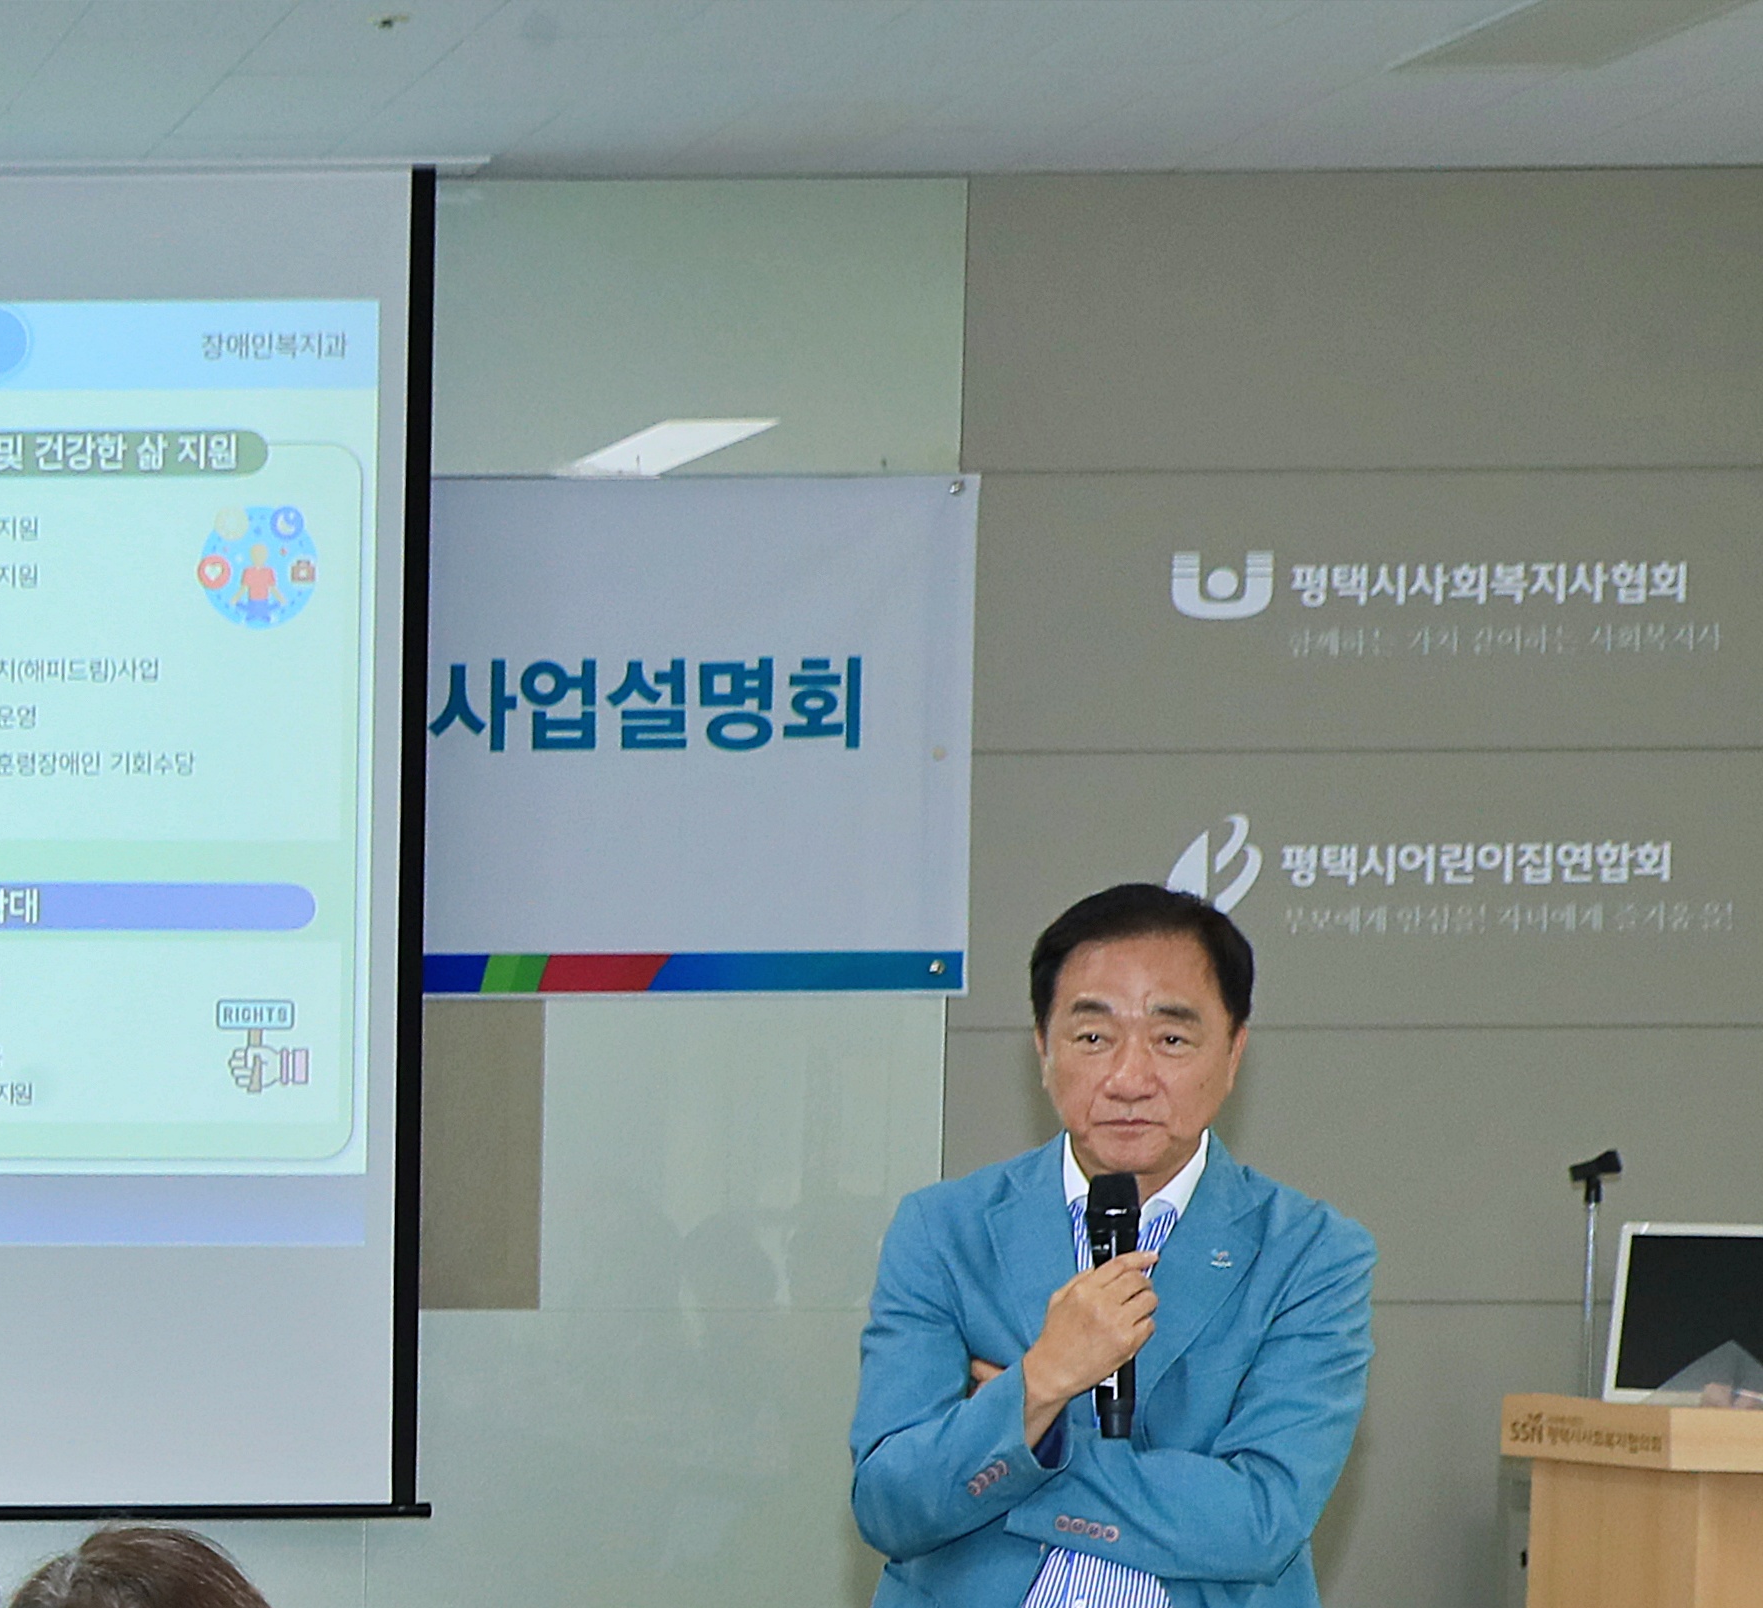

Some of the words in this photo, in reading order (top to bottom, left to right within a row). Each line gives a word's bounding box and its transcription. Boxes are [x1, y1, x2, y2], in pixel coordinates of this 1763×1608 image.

[201, 332, 348, 361] 장애인복지과
[34, 433, 128, 473] 건강한
[136, 433, 168, 473] 삶
[177, 433, 239, 473] 지원
[1290, 560, 1690, 607] 평택시사회복지사협회
[429, 655, 863, 753] 사업설명회
[109, 751, 196, 778] 기회수당
[1281, 840, 1674, 889] 평택시어린이집연합회
[223, 1007, 288, 1023] RIGHTS
